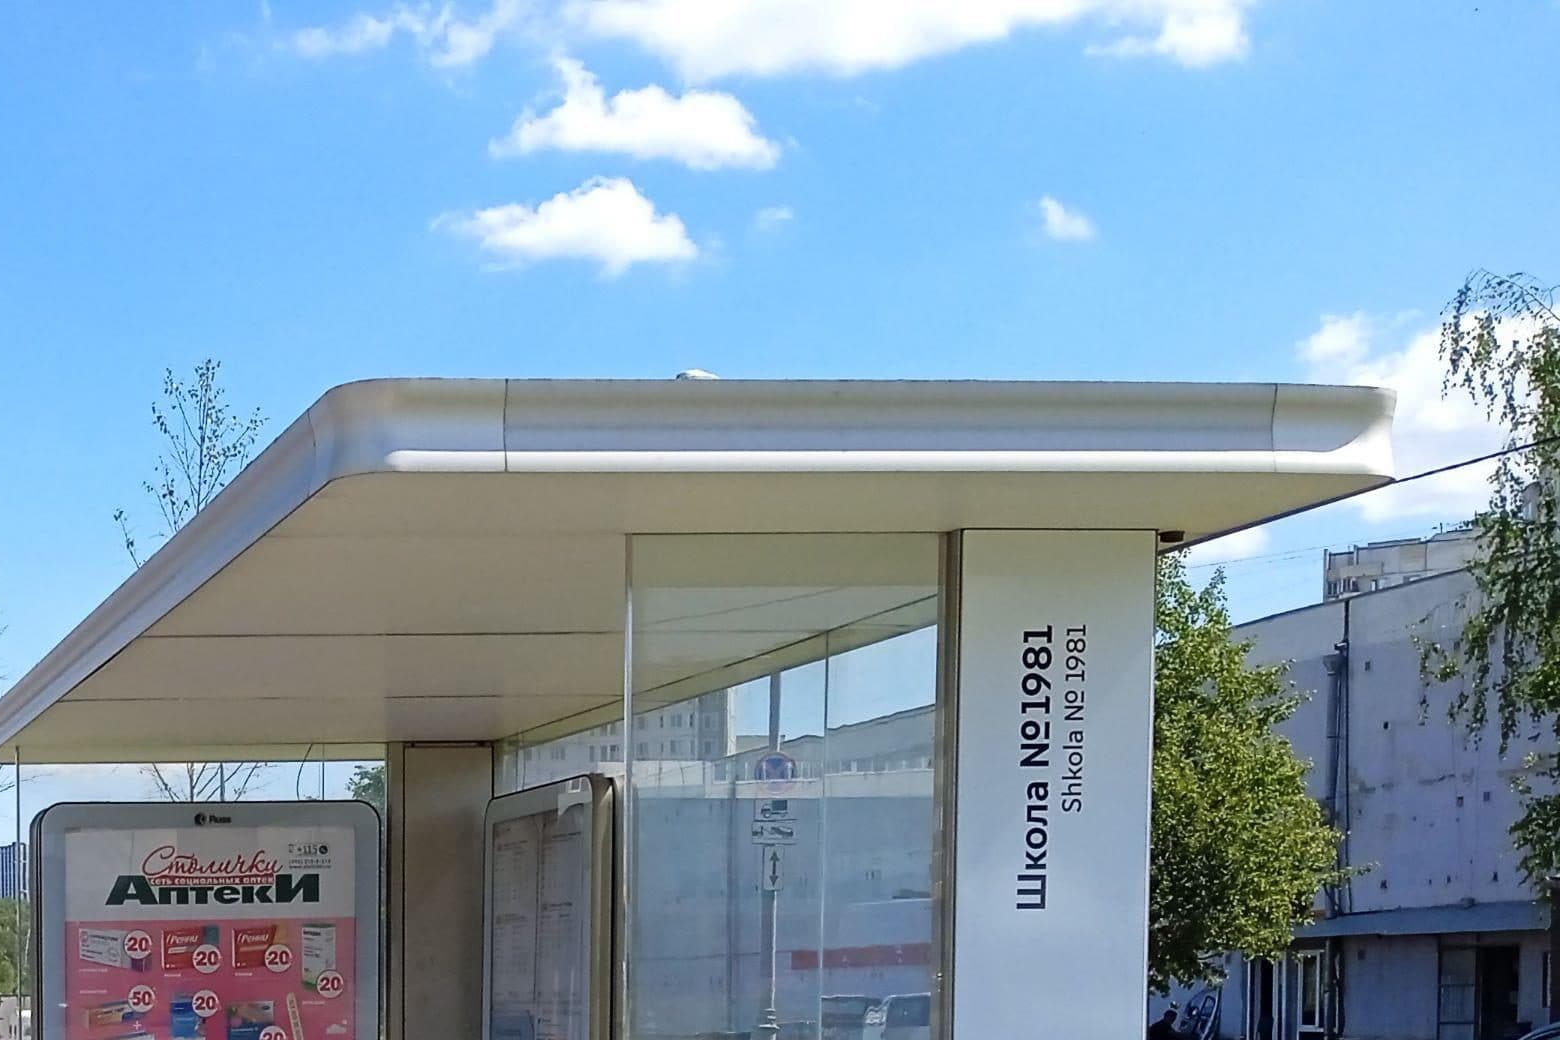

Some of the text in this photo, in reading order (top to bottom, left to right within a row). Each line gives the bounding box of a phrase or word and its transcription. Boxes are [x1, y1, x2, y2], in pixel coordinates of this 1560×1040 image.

[1061, 624, 1087, 812] Shkola № 1981
[142, 846, 283, 875] Столички
[175, 877, 240, 886] социальных
[1016, 781, 1048, 910] Школа
